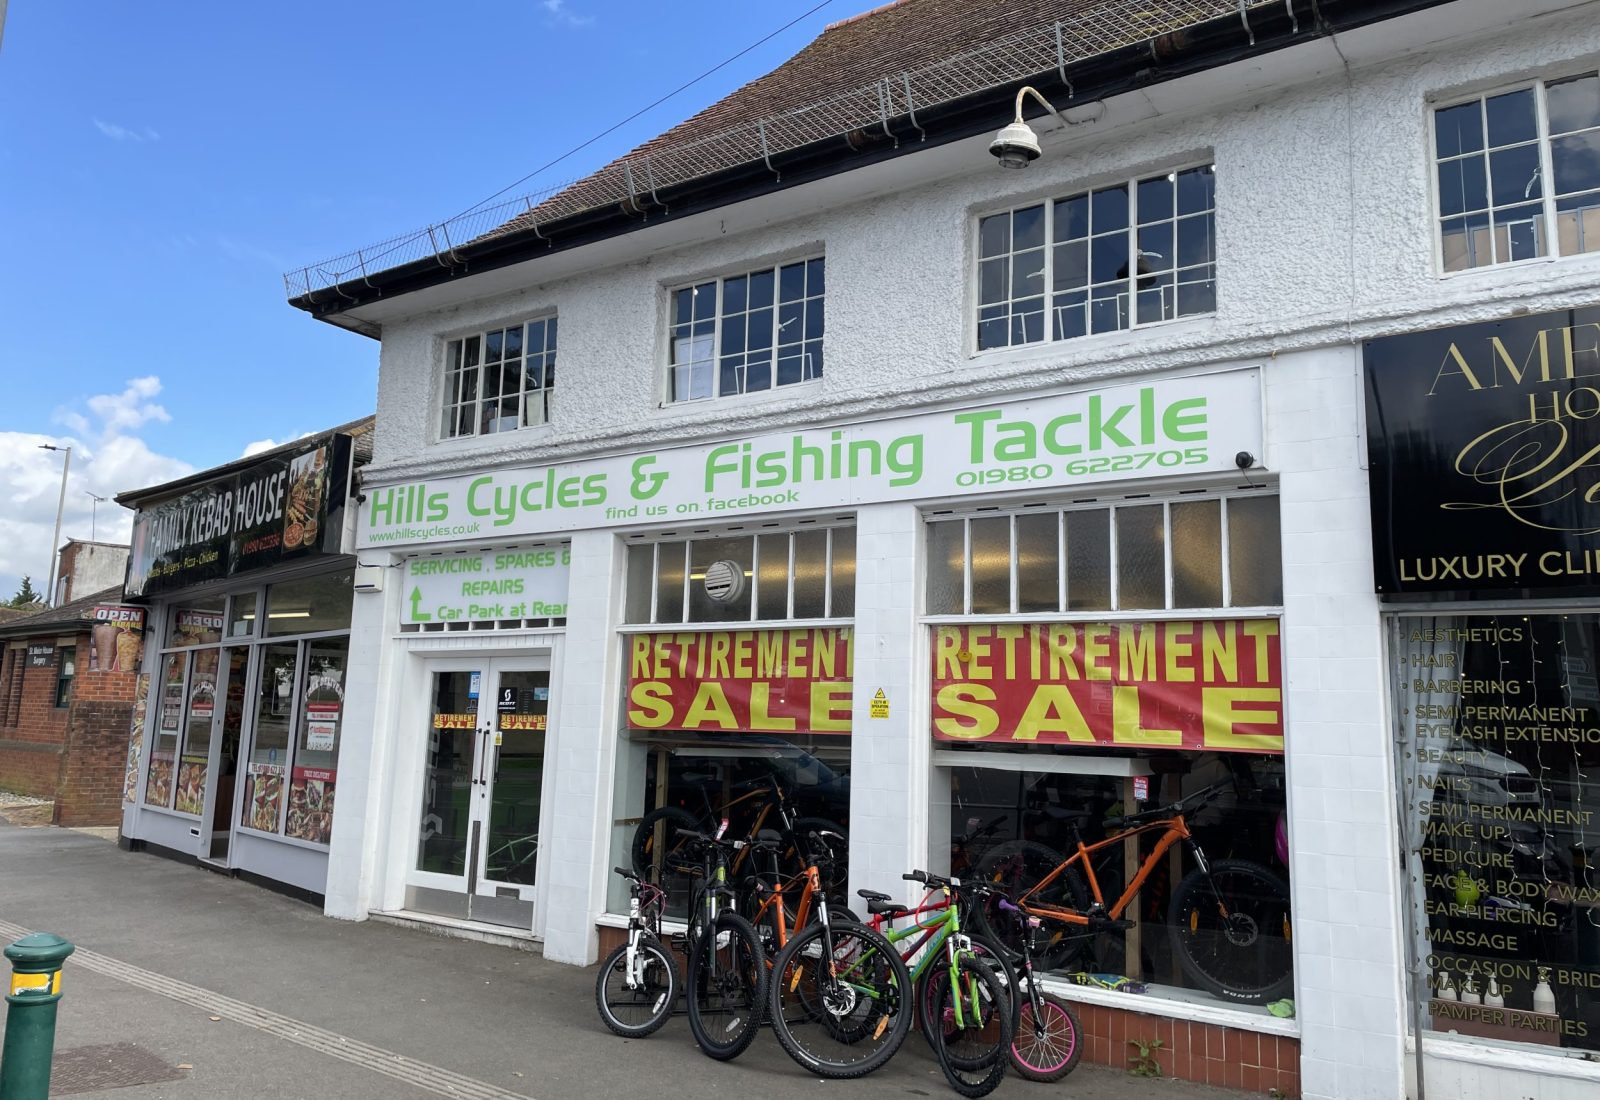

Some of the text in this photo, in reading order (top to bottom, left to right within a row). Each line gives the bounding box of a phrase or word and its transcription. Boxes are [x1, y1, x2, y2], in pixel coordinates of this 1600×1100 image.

[370, 387, 1208, 527] Hills Cycles & Fishing Tackle
[956, 447, 1209, 487] 01980 622705
[150, 471, 286, 557] FAMILY KEBAB HOUSE
[605, 505, 638, 519] find
[646, 504, 668, 516] us
[707, 489, 800, 511] facebook
[369, 522, 480, 542] www.hillscycles.co.uk
[410, 556, 482, 577] SERVICING
[495, 551, 557, 571] SPARES
[1400, 549, 1600, 581] LUXURY CLI
[461, 578, 524, 597] REPAIRS
[96, 609, 141, 621] OPEN
[437, 601, 568, 621] Car Park at Rear
[1411, 628, 1523, 643] AESTHETICS
[632, 628, 853, 680] RETIREMENT
[937, 619, 1279, 683] RETIREMENT
[1411, 654, 1455, 668] HAIR
[1413, 679, 1521, 694] BARBERING
[434, 714, 476, 722] RETIREMENT
[629, 681, 852, 731] SALE
[934, 684, 1283, 750] SALE
[1415, 704, 1589, 723] SEMI PERMANENT
[434, 721, 475, 729] SALE
[501, 722, 546, 730] SALE
[1416, 724, 1498, 741] EYELASH
[1417, 749, 1489, 765] BEAUTY
[1418, 774, 1472, 791] NAILS
[1419, 800, 1594, 826] SEMI PERMANENT
[1420, 820, 1505, 840] MAKE UP
[1421, 848, 1515, 868] PEDICURE
[1423, 874, 1471, 891] FACE
[1477, 878, 1490, 893] &
[1496, 880, 1552, 898] BODY
[1424, 900, 1558, 927] EAR PIERCING
[1425, 927, 1519, 951] MASSAGE
[1426, 954, 1531, 981] OCCASION
[1538, 966, 1552, 983] &
[1426, 974, 1513, 998] MAKE UP
[1428, 1000, 1588, 1036] PAMPER PARTIES
